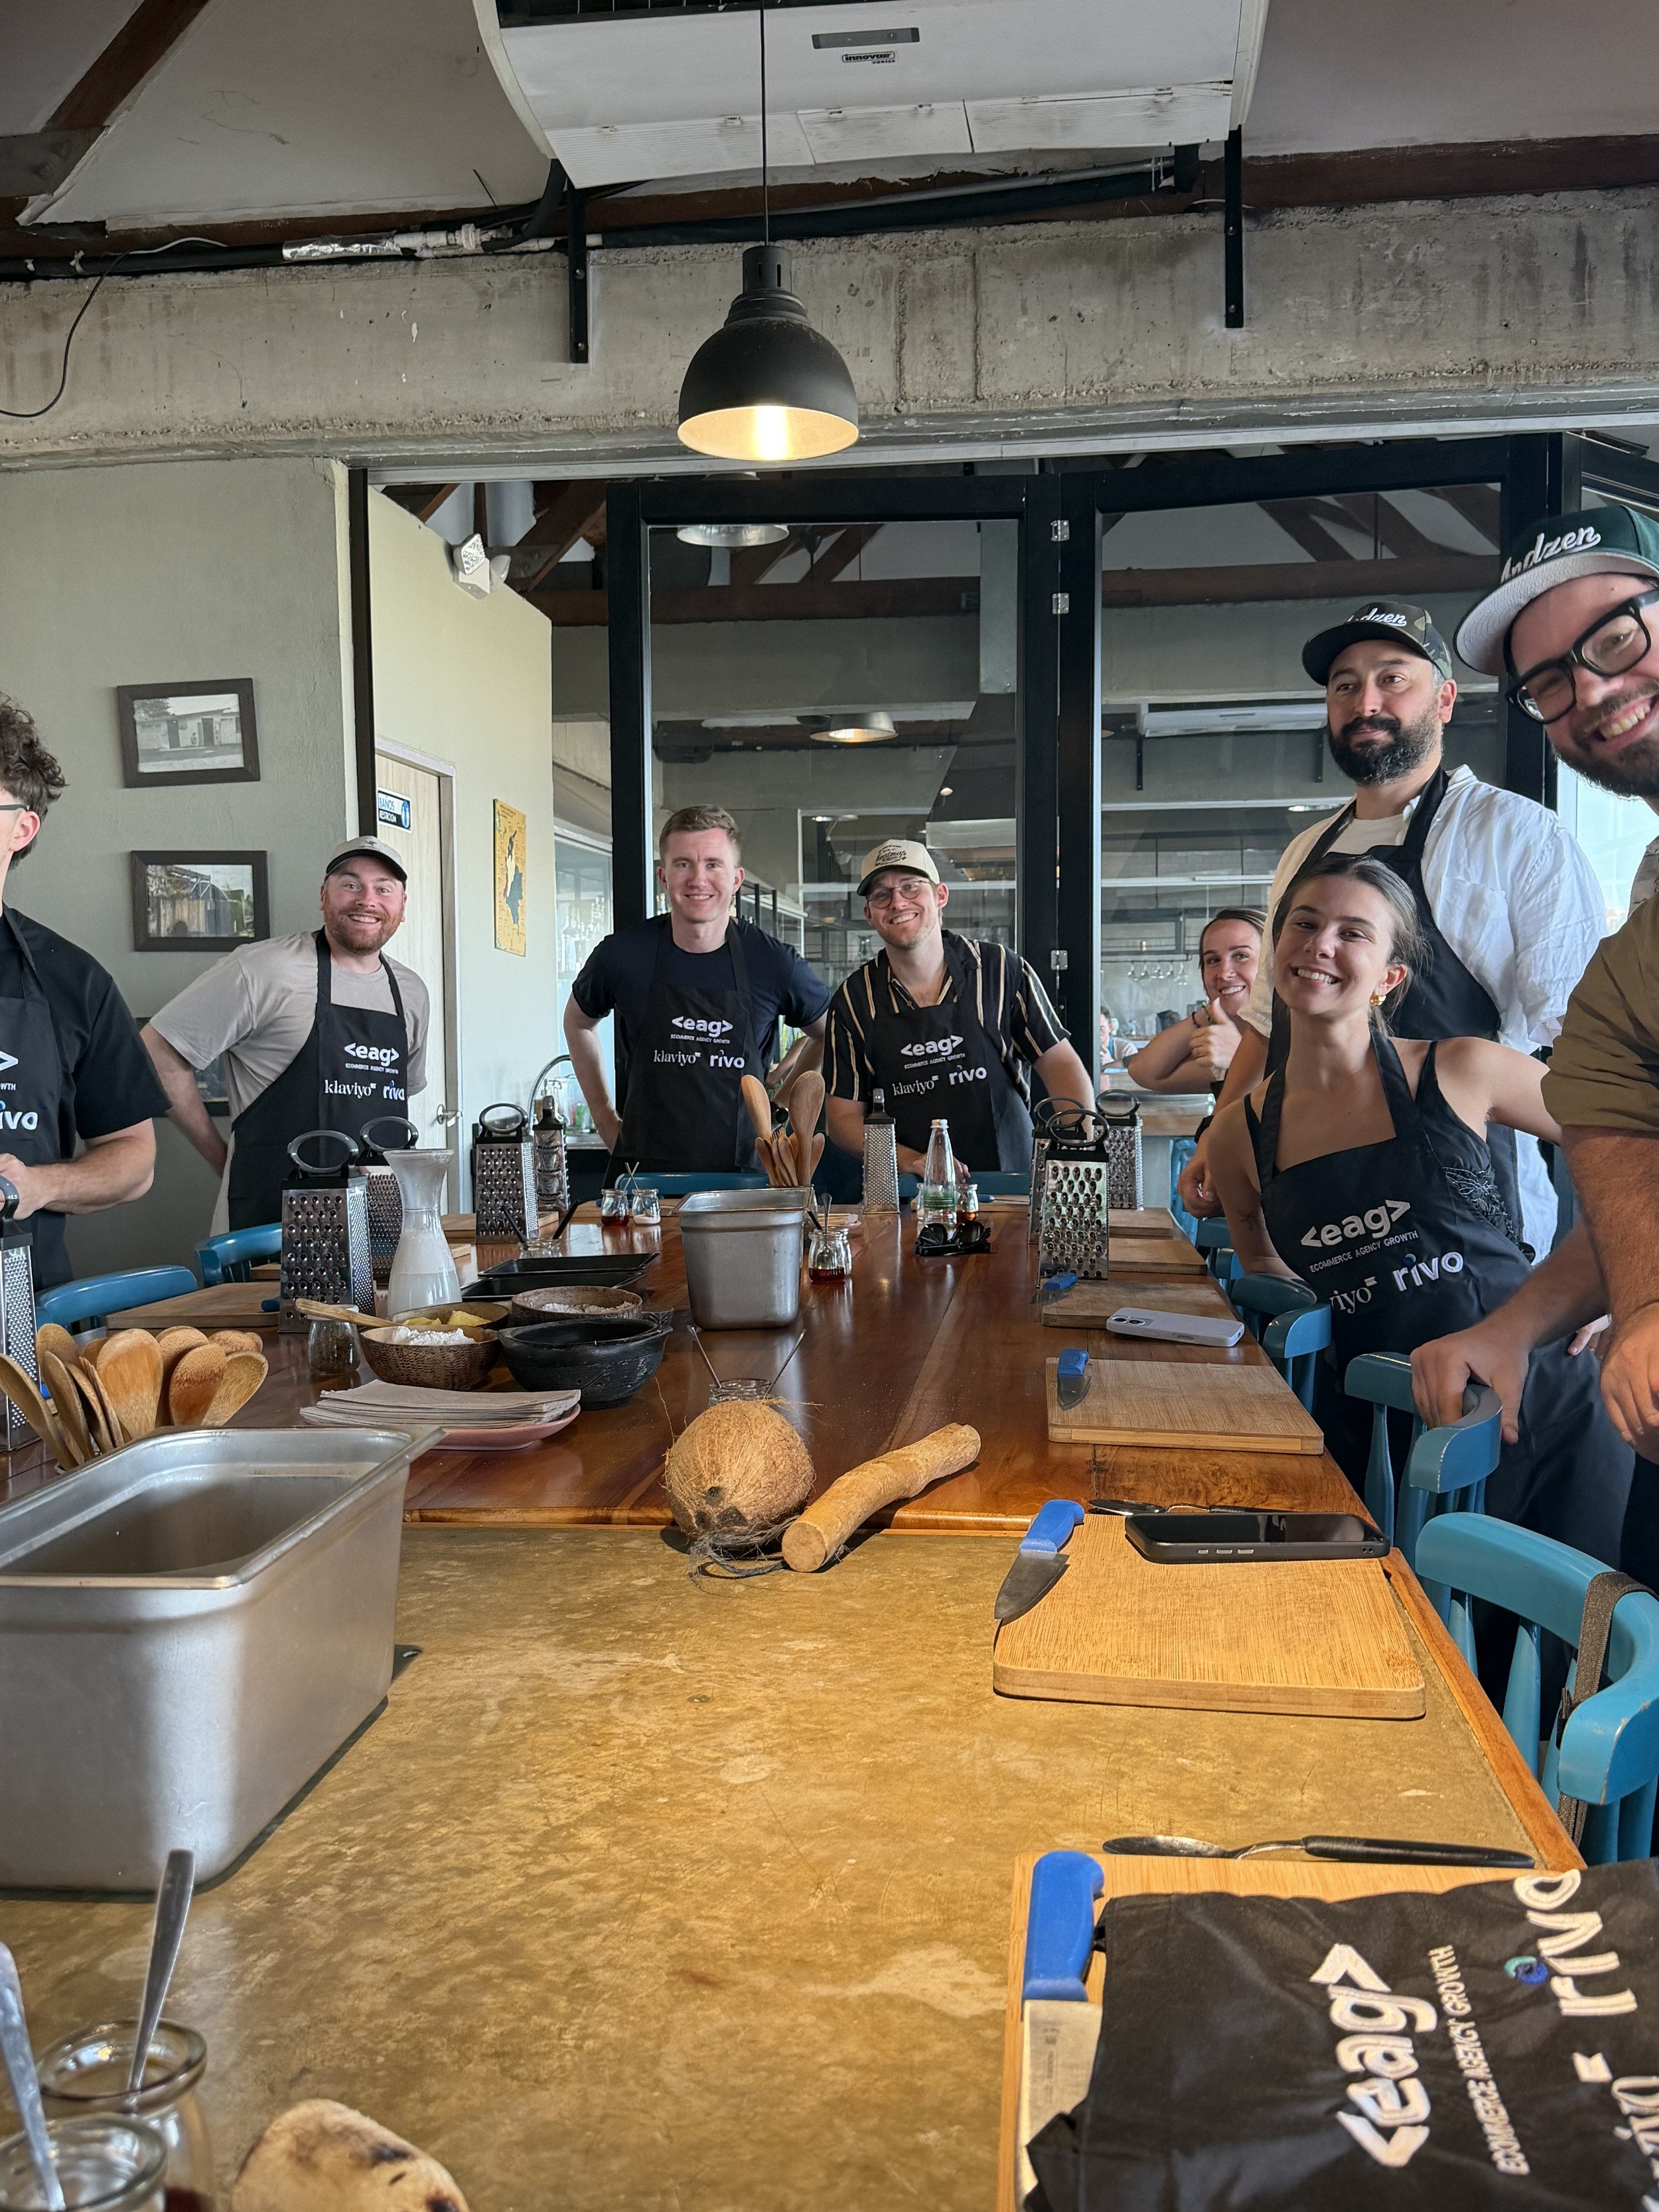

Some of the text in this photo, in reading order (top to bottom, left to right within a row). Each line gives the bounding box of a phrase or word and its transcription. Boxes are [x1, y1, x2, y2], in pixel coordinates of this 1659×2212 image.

[672, 1016, 733, 1037] <eag>
[344, 1043, 399, 1067] <eag>
[653, 1049, 745, 1069] klaviyo rivo
[901, 1035, 964, 1056] <eag>
[325, 1079, 372, 1099] klaviyo
[892, 1065, 987, 1096] klaviyo rivo
[1301, 1199, 1411, 1248] <eag>
[1310, 1230, 1419, 1272] ECOMMERCE AGENCY GROWTH
[1392, 1252, 1464, 1292] rivo
[1504, 1868, 1638, 2016] rivo
[1309, 1943, 1437, 2168] <eag>
[1428, 1945, 1531, 2176] ECOMMERCE AGENCY GROWTH
